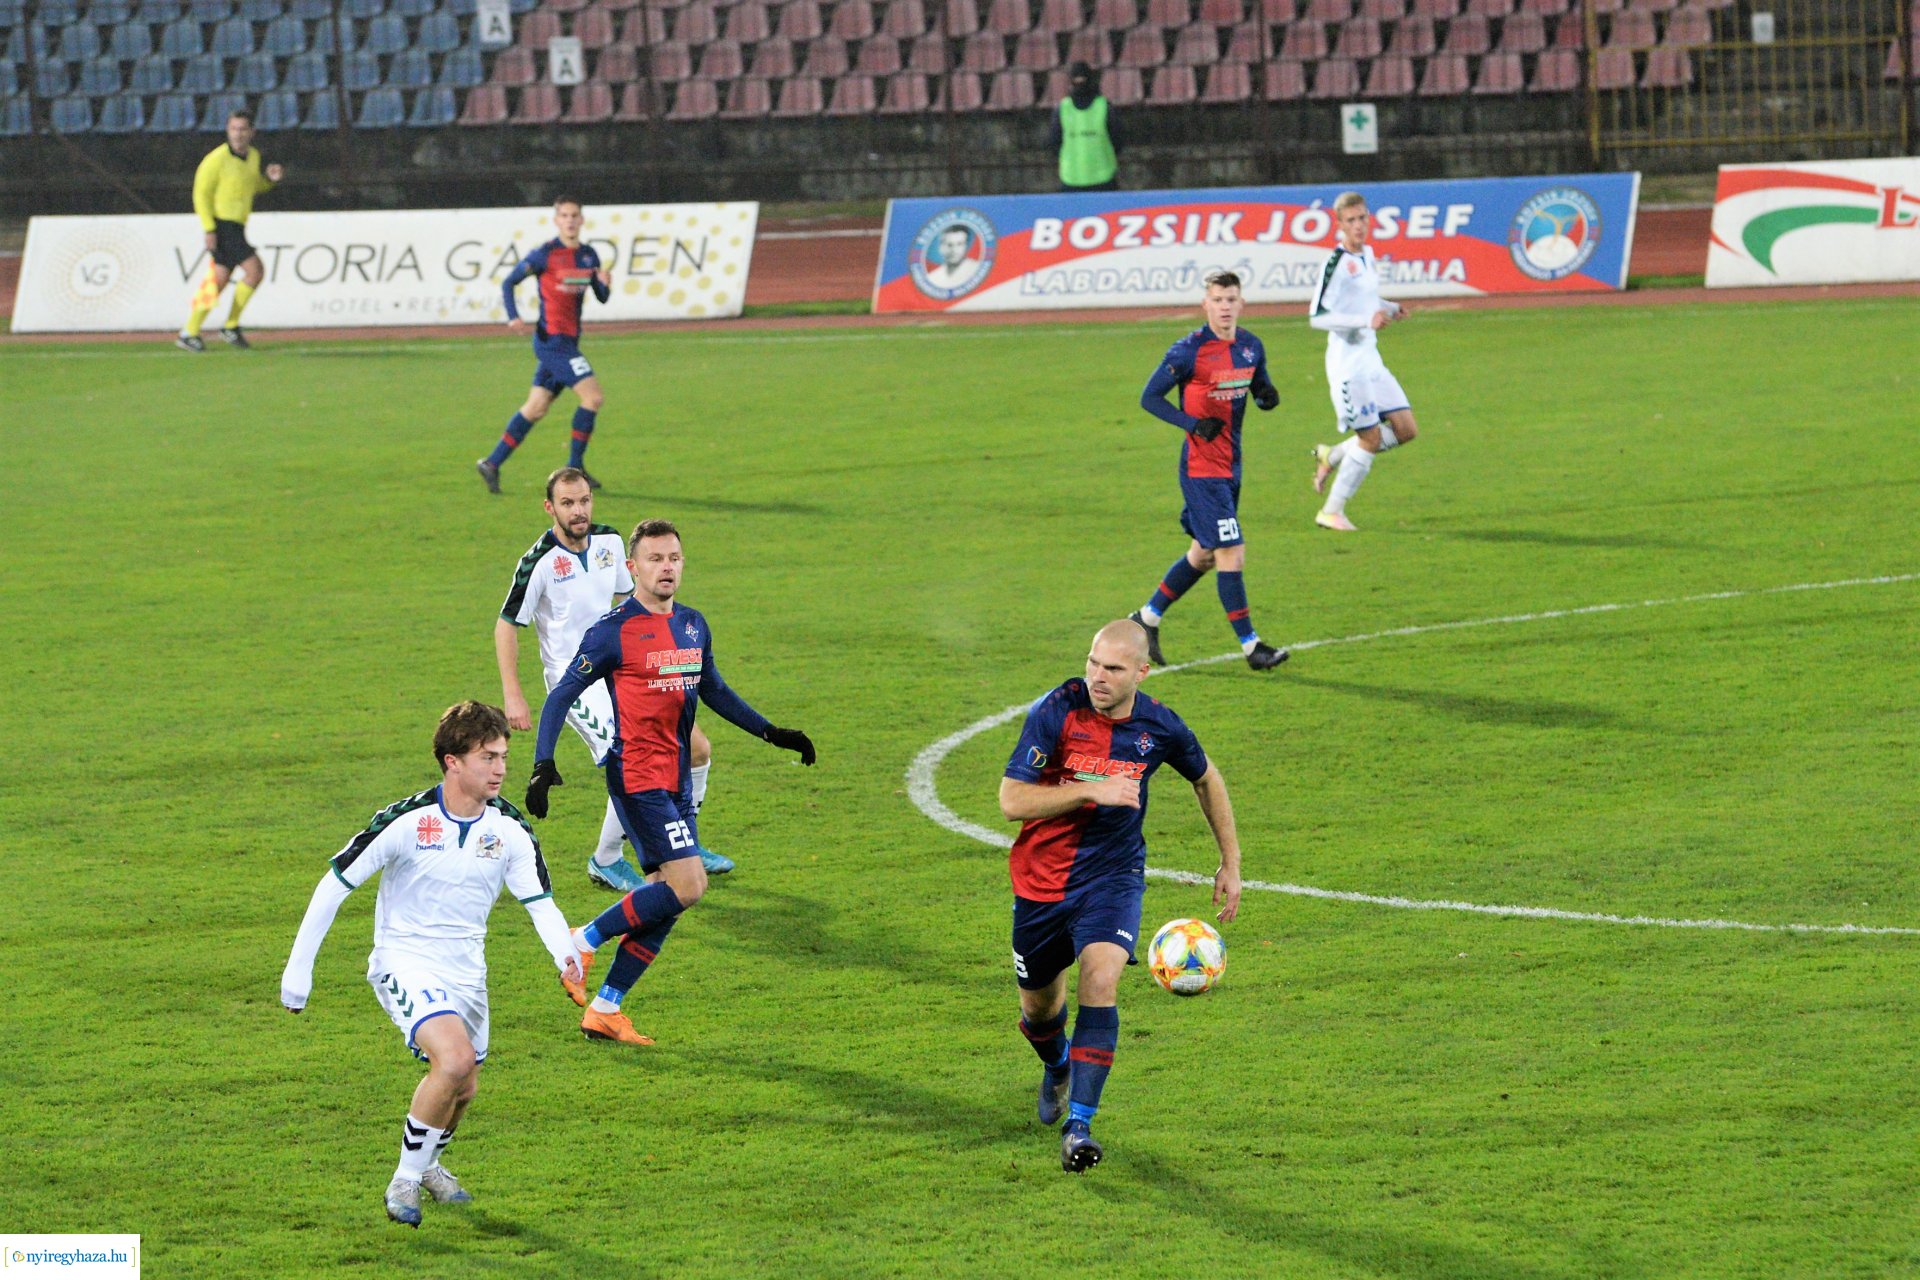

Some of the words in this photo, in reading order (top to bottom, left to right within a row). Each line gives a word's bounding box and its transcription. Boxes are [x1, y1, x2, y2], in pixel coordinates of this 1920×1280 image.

[488, 15, 505, 35] A
[558, 58, 576, 78] A
[1029, 210, 1243, 251] BOZSIK
[1258, 198, 1474, 243] JÓSEF
[175, 241, 424, 284] VTORIA
[445, 235, 708, 282] GADEN
[1260, 254, 1467, 289] AKÉMIA
[310, 297, 383, 314] HOTEL
[1217, 517, 1240, 541] 20
[664, 820, 694, 850] 22
[421, 987, 447, 1003] 17
